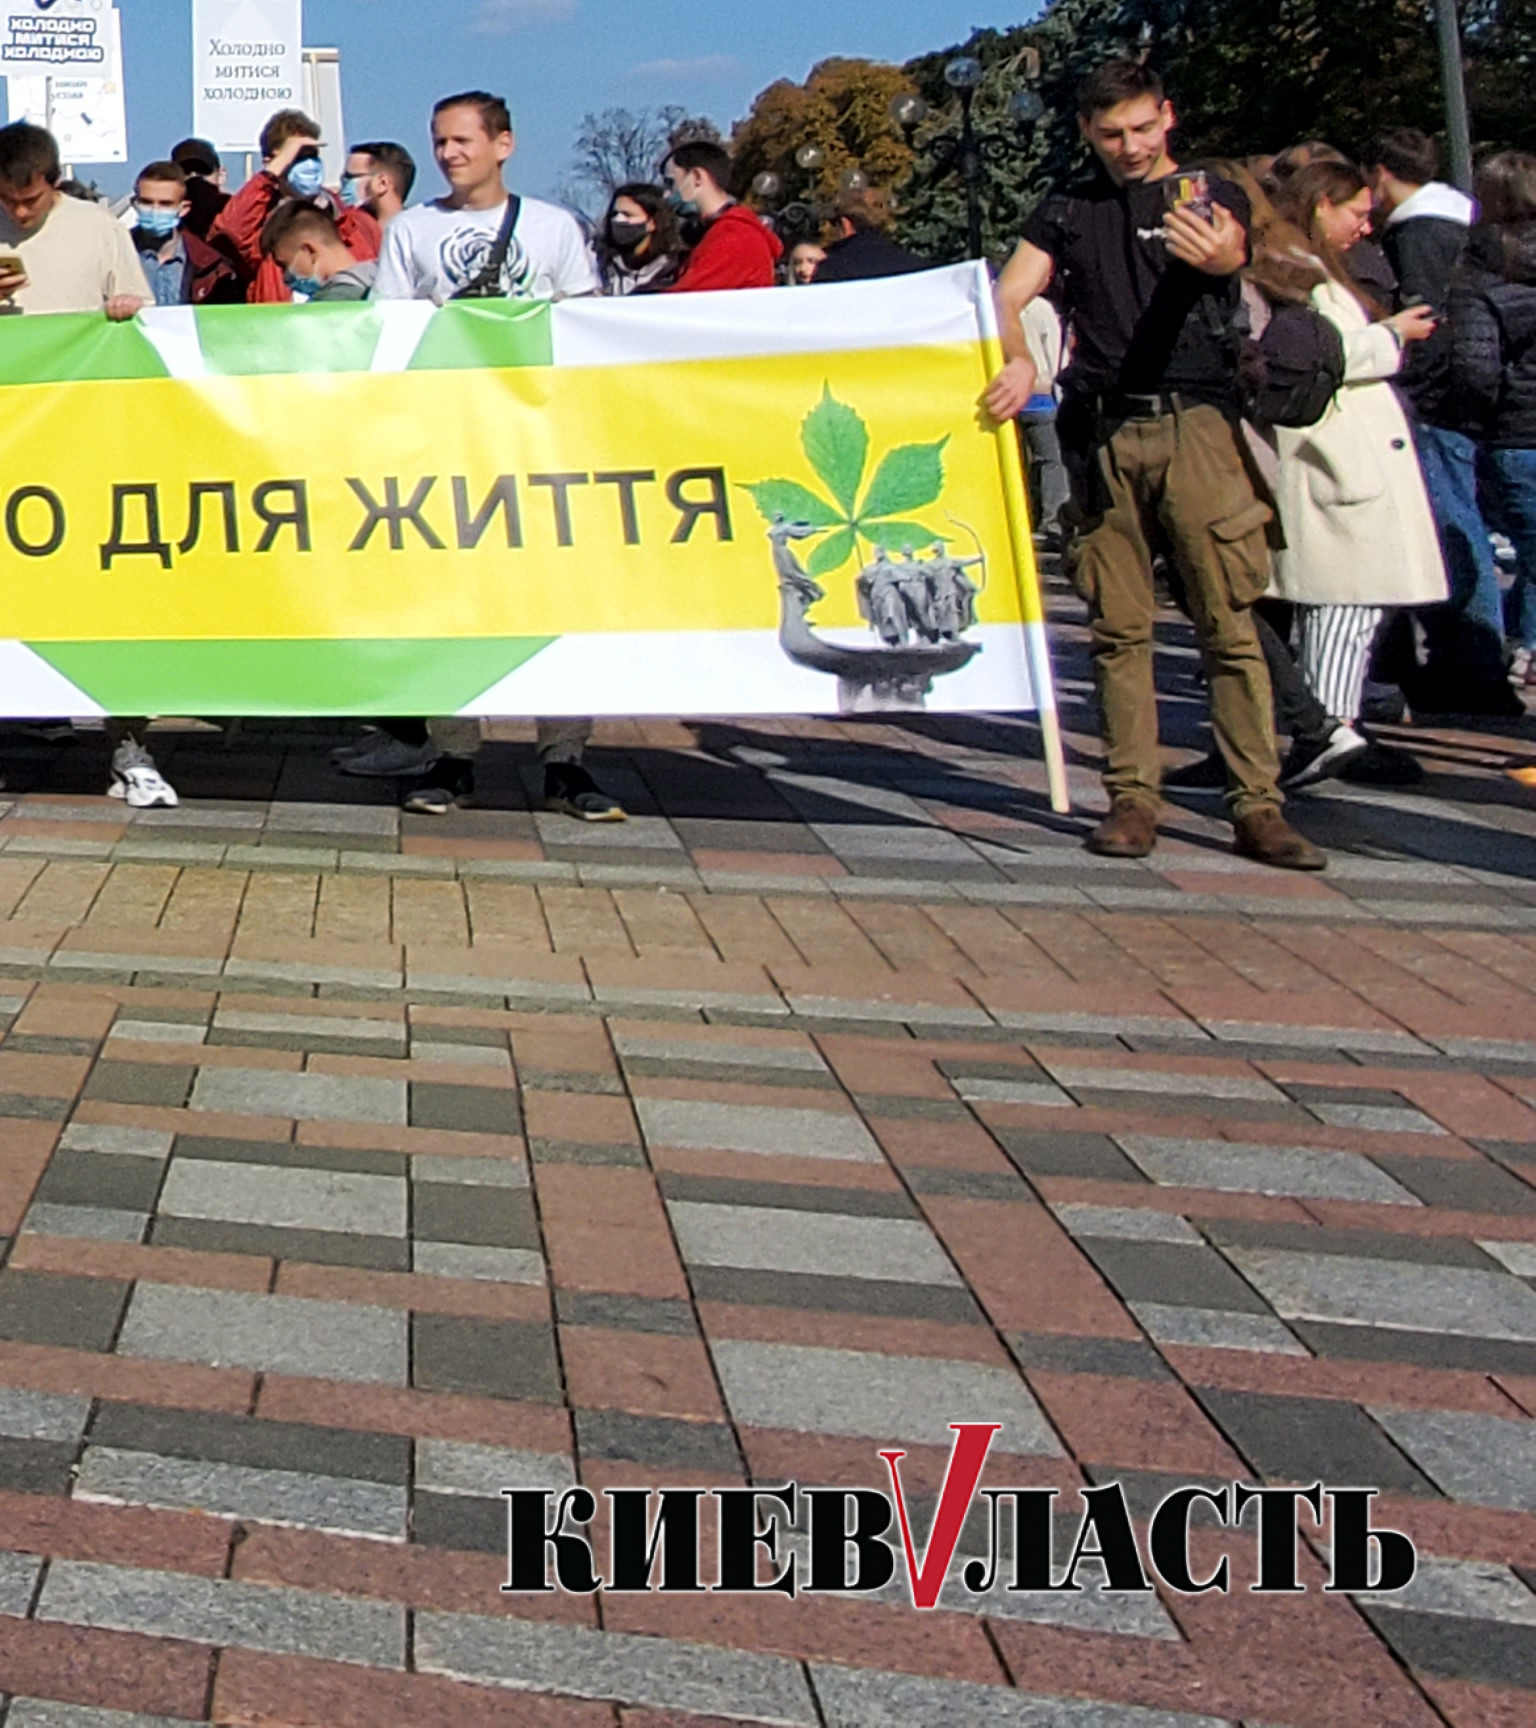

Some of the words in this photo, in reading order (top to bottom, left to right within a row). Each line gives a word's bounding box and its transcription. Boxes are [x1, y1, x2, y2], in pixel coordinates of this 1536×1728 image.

[9, 16, 97, 33] ХОЛОДНО
[14, 32, 92, 47] МИТИСЯ
[209, 38, 286, 57] Холодно
[2, 45, 103, 63] ХОЛОДНОЮ
[215, 64, 280, 78] митися
[203, 87, 293, 101] холодною
[99, 479, 311, 570] ДЛЯ
[346, 466, 734, 552] ЖИТТЯ
